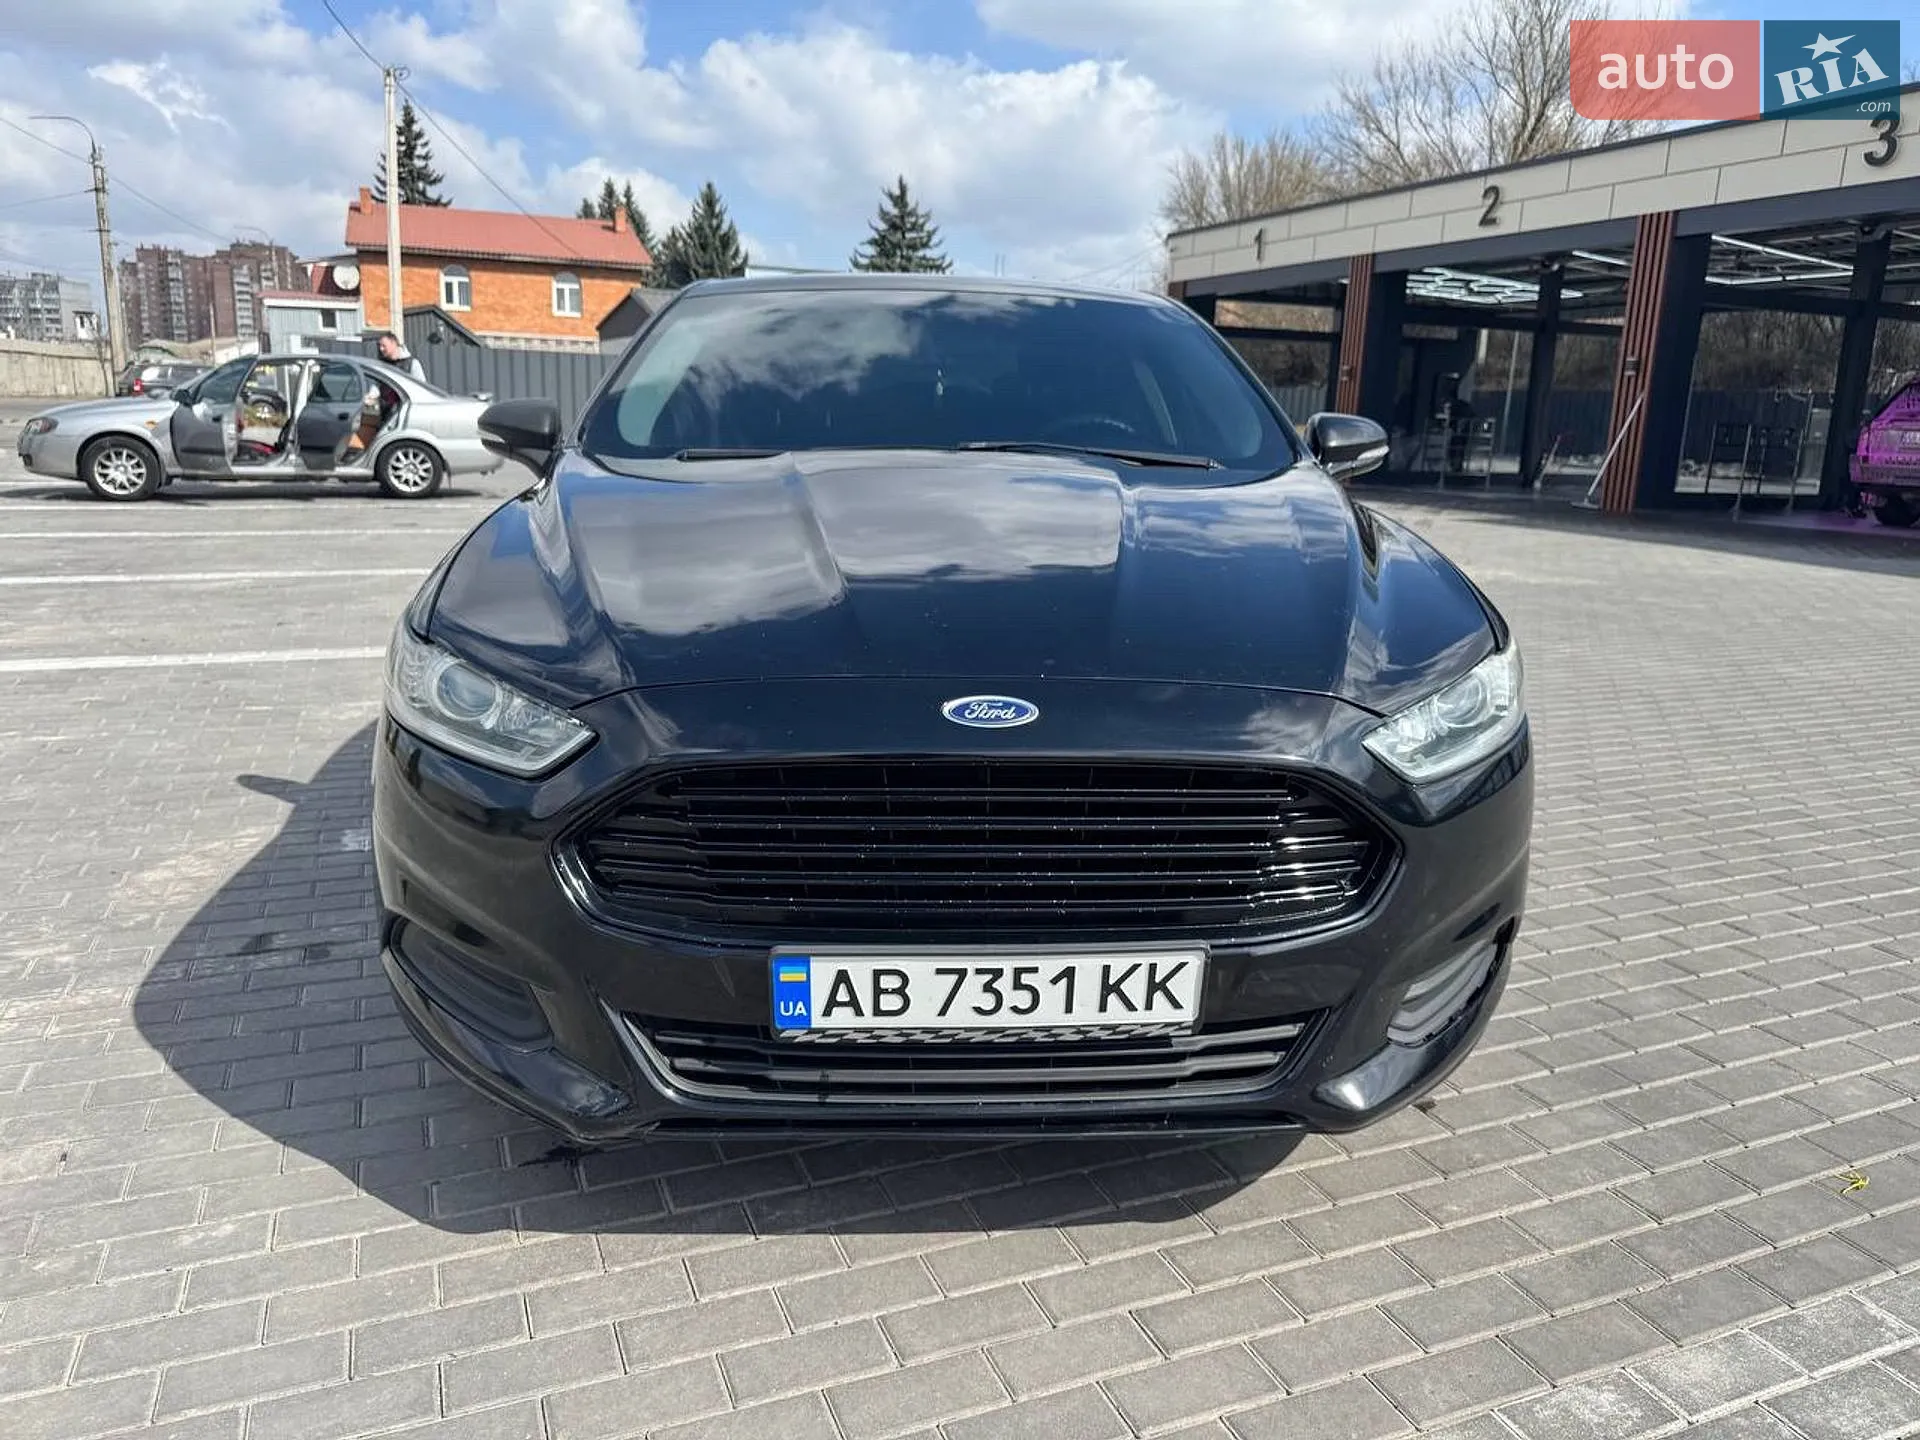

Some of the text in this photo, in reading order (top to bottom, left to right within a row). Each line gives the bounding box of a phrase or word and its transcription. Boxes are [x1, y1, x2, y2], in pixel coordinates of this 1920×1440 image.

[1863, 112, 1900, 166] 3
[1479, 185, 1500, 226] 2
[1254, 228, 1263, 261] 1
[965, 702, 1016, 720] Ford
[822, 961, 1190, 1017] AB 7351 KK
[780, 1001, 807, 1017] UA
